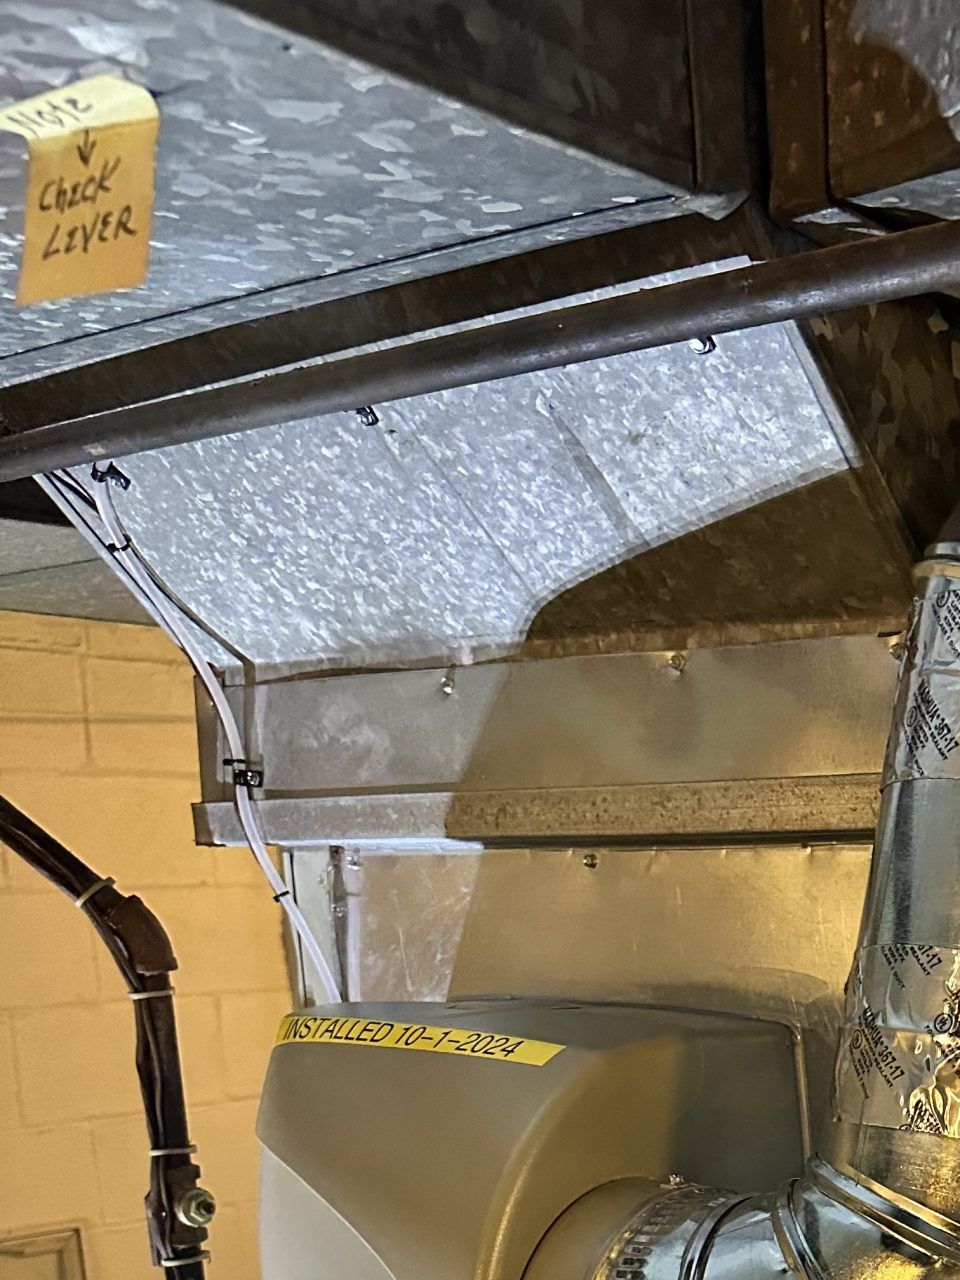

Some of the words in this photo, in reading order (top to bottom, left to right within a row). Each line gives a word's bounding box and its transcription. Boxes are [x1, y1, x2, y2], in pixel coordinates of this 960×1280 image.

[42, 205, 137, 260] LEVER
[934, 717, 960, 753] 367-17
[283, 1017, 395, 1042] INSTALLED
[395, 1026, 524, 1057] 10-1-2024
[878, 1045, 905, 1080] 367-17
